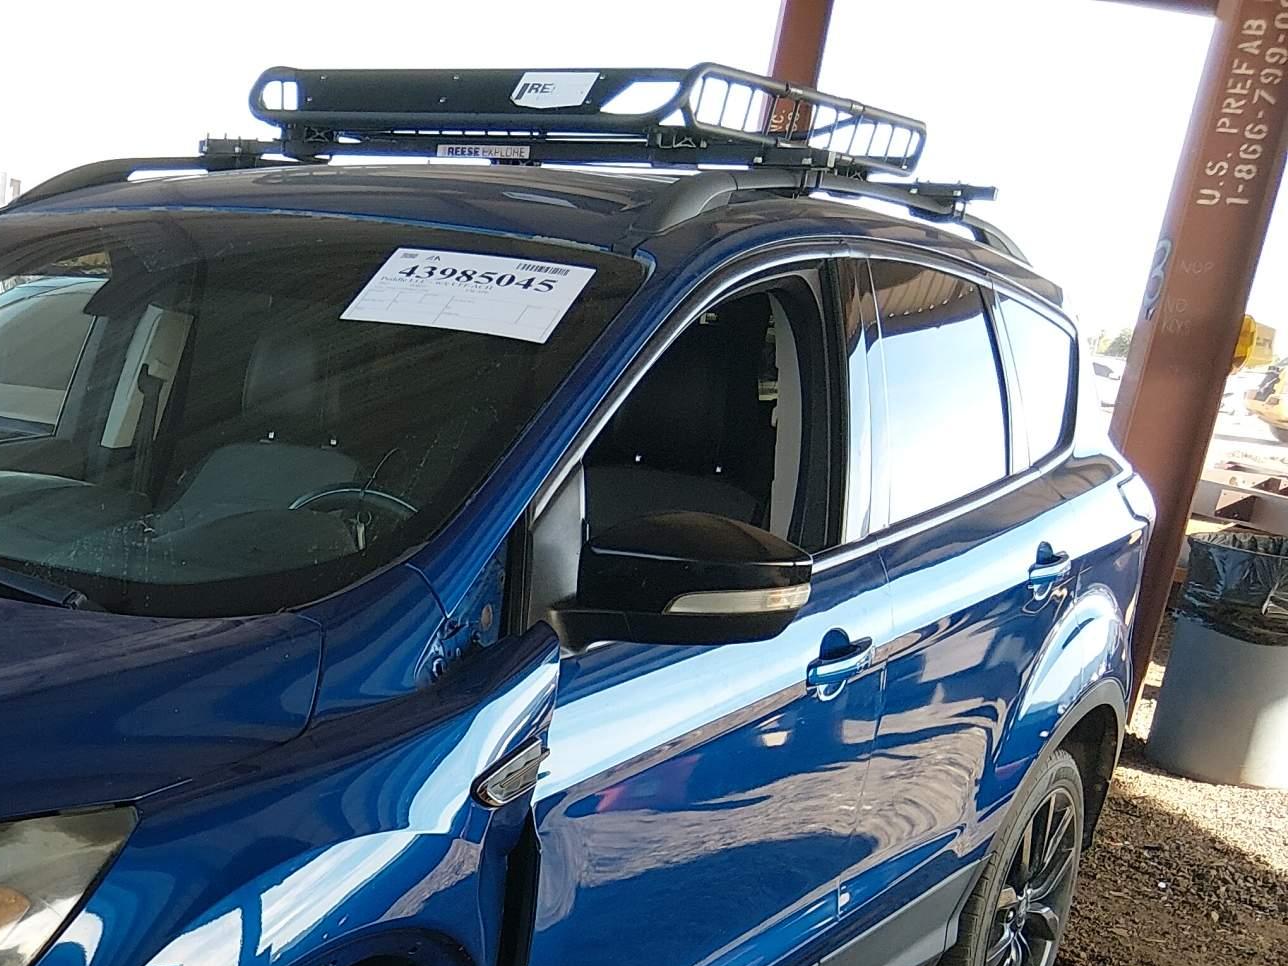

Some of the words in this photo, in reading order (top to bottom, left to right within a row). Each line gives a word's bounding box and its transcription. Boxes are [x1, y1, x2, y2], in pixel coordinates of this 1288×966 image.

[447, 146, 481, 156] REESE
[1196, 152, 1233, 206] U.S.
[1216, 19, 1267, 134] PREFAB
[1226, 0, 1288, 205] 1-866-799-0
[398, 264, 559, 293] 43985045
